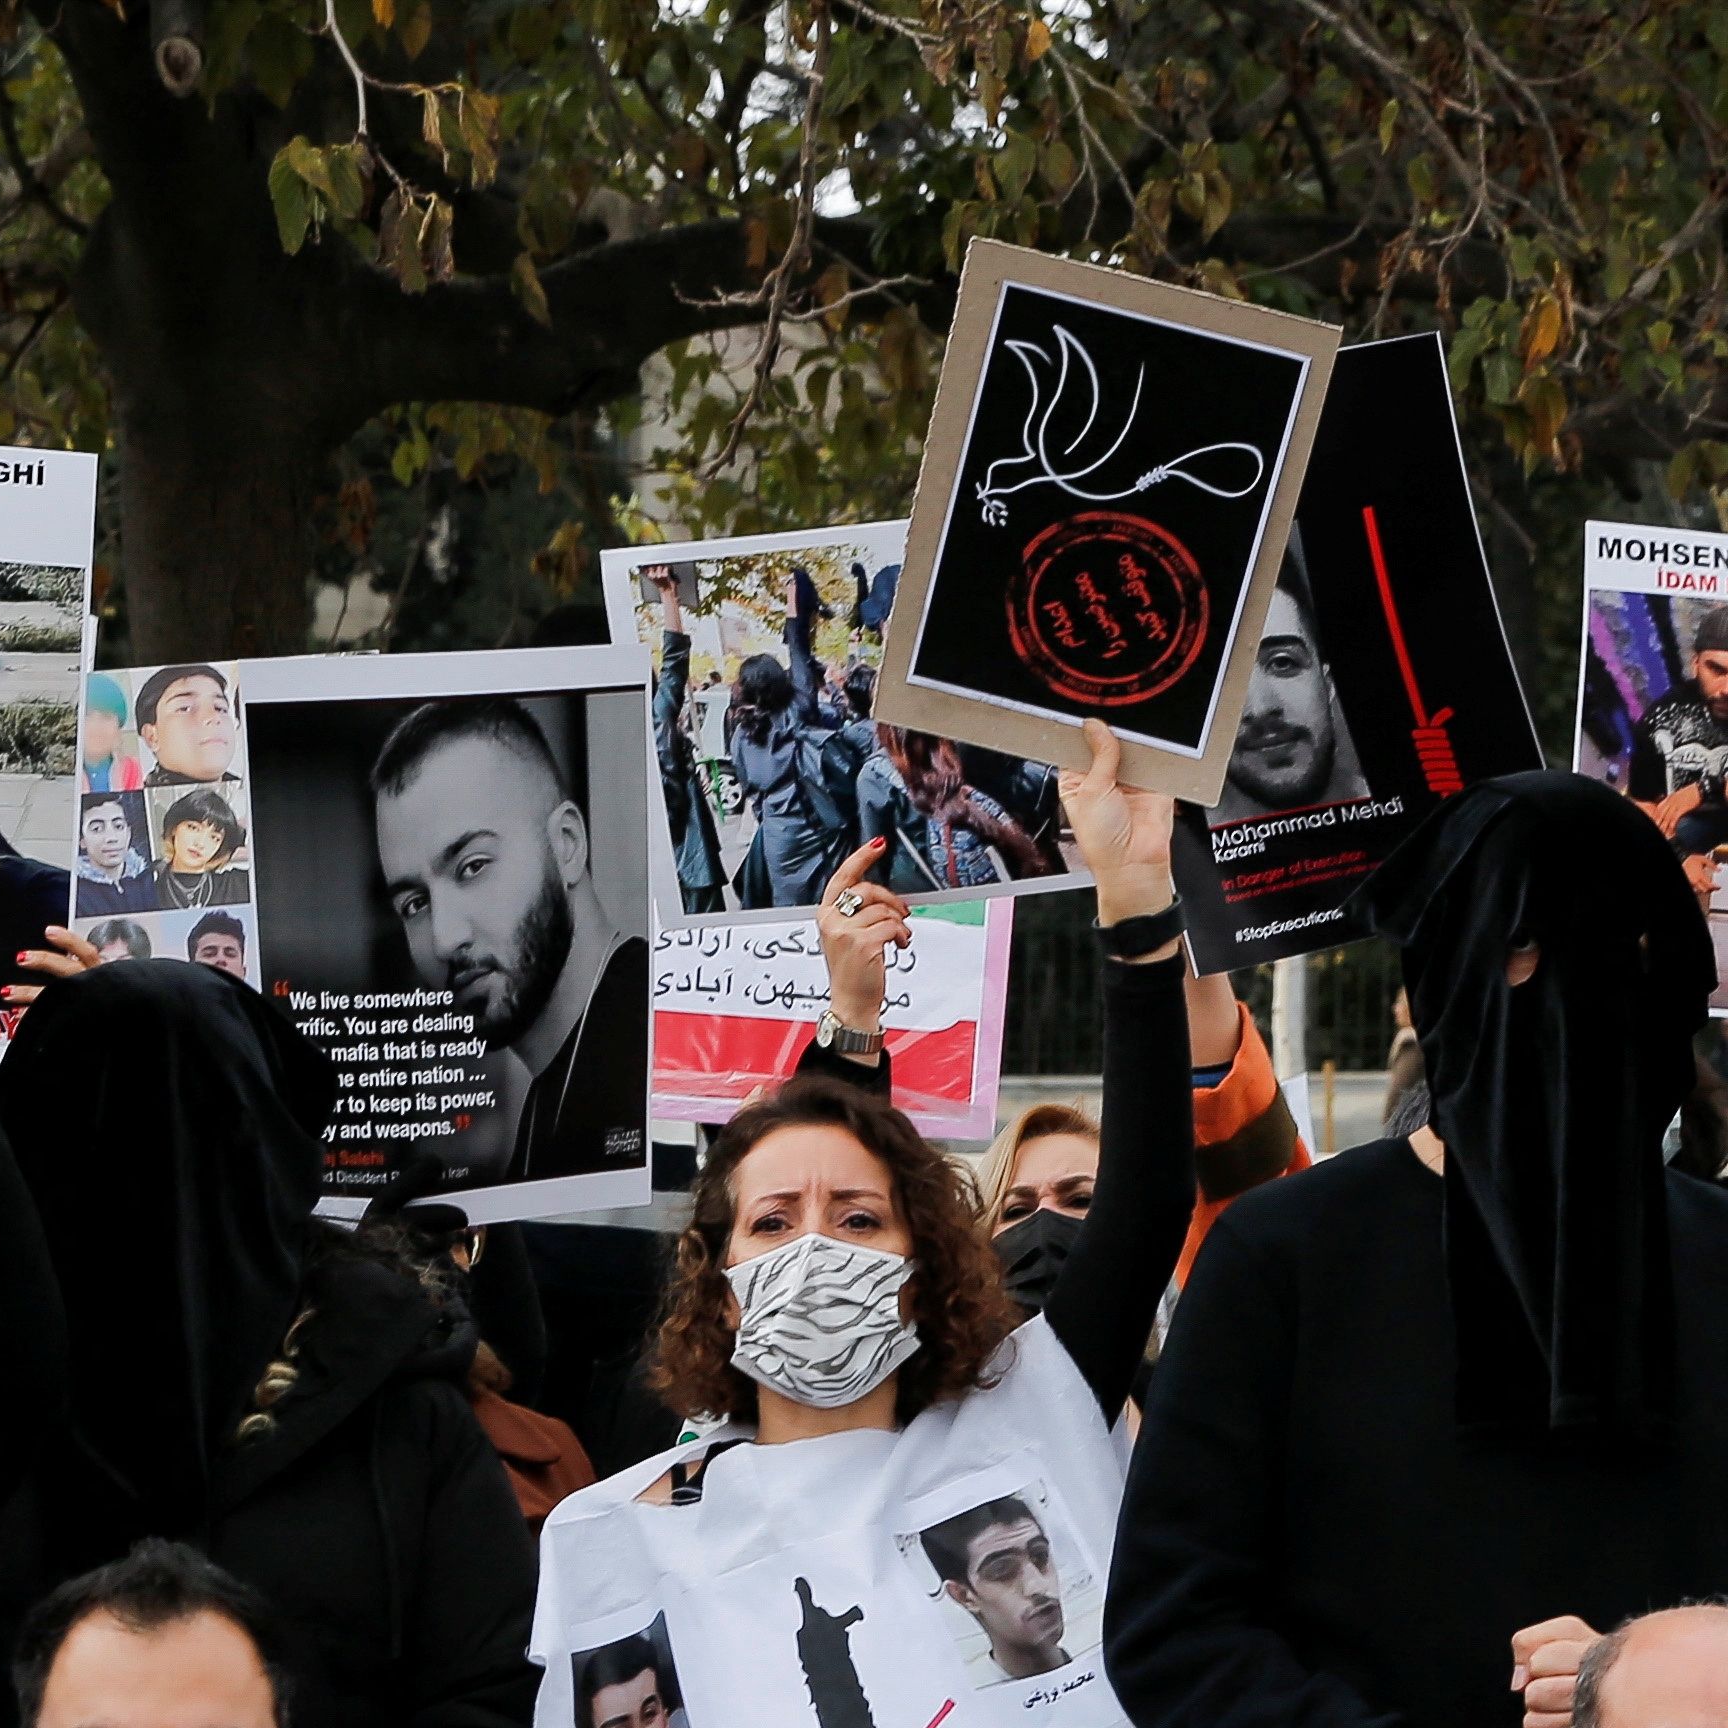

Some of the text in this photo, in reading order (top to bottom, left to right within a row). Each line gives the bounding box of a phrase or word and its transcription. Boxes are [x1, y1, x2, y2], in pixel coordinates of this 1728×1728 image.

[1656, 567, 1717, 593] İDAM
[1211, 796, 1404, 850] Mohammad Mehdi
[1214, 840, 1266, 863] Karami
[1235, 907, 1345, 943] #StopExecutions
[321, 990, 350, 1010] live
[354, 988, 454, 1009] somewhere
[344, 1016, 376, 1035] You
[380, 1018, 408, 1034] are
[412, 1012, 474, 1034] dealing
[331, 1036, 488, 1062] mafia that is ready
[359, 1067, 407, 1086] entire
[412, 1065, 465, 1085] nation
[348, 1096, 365, 1113] to
[370, 1094, 412, 1115] keep
[416, 1092, 436, 1111] its
[441, 1091, 496, 1113] power,
[340, 1121, 372, 1139] and
